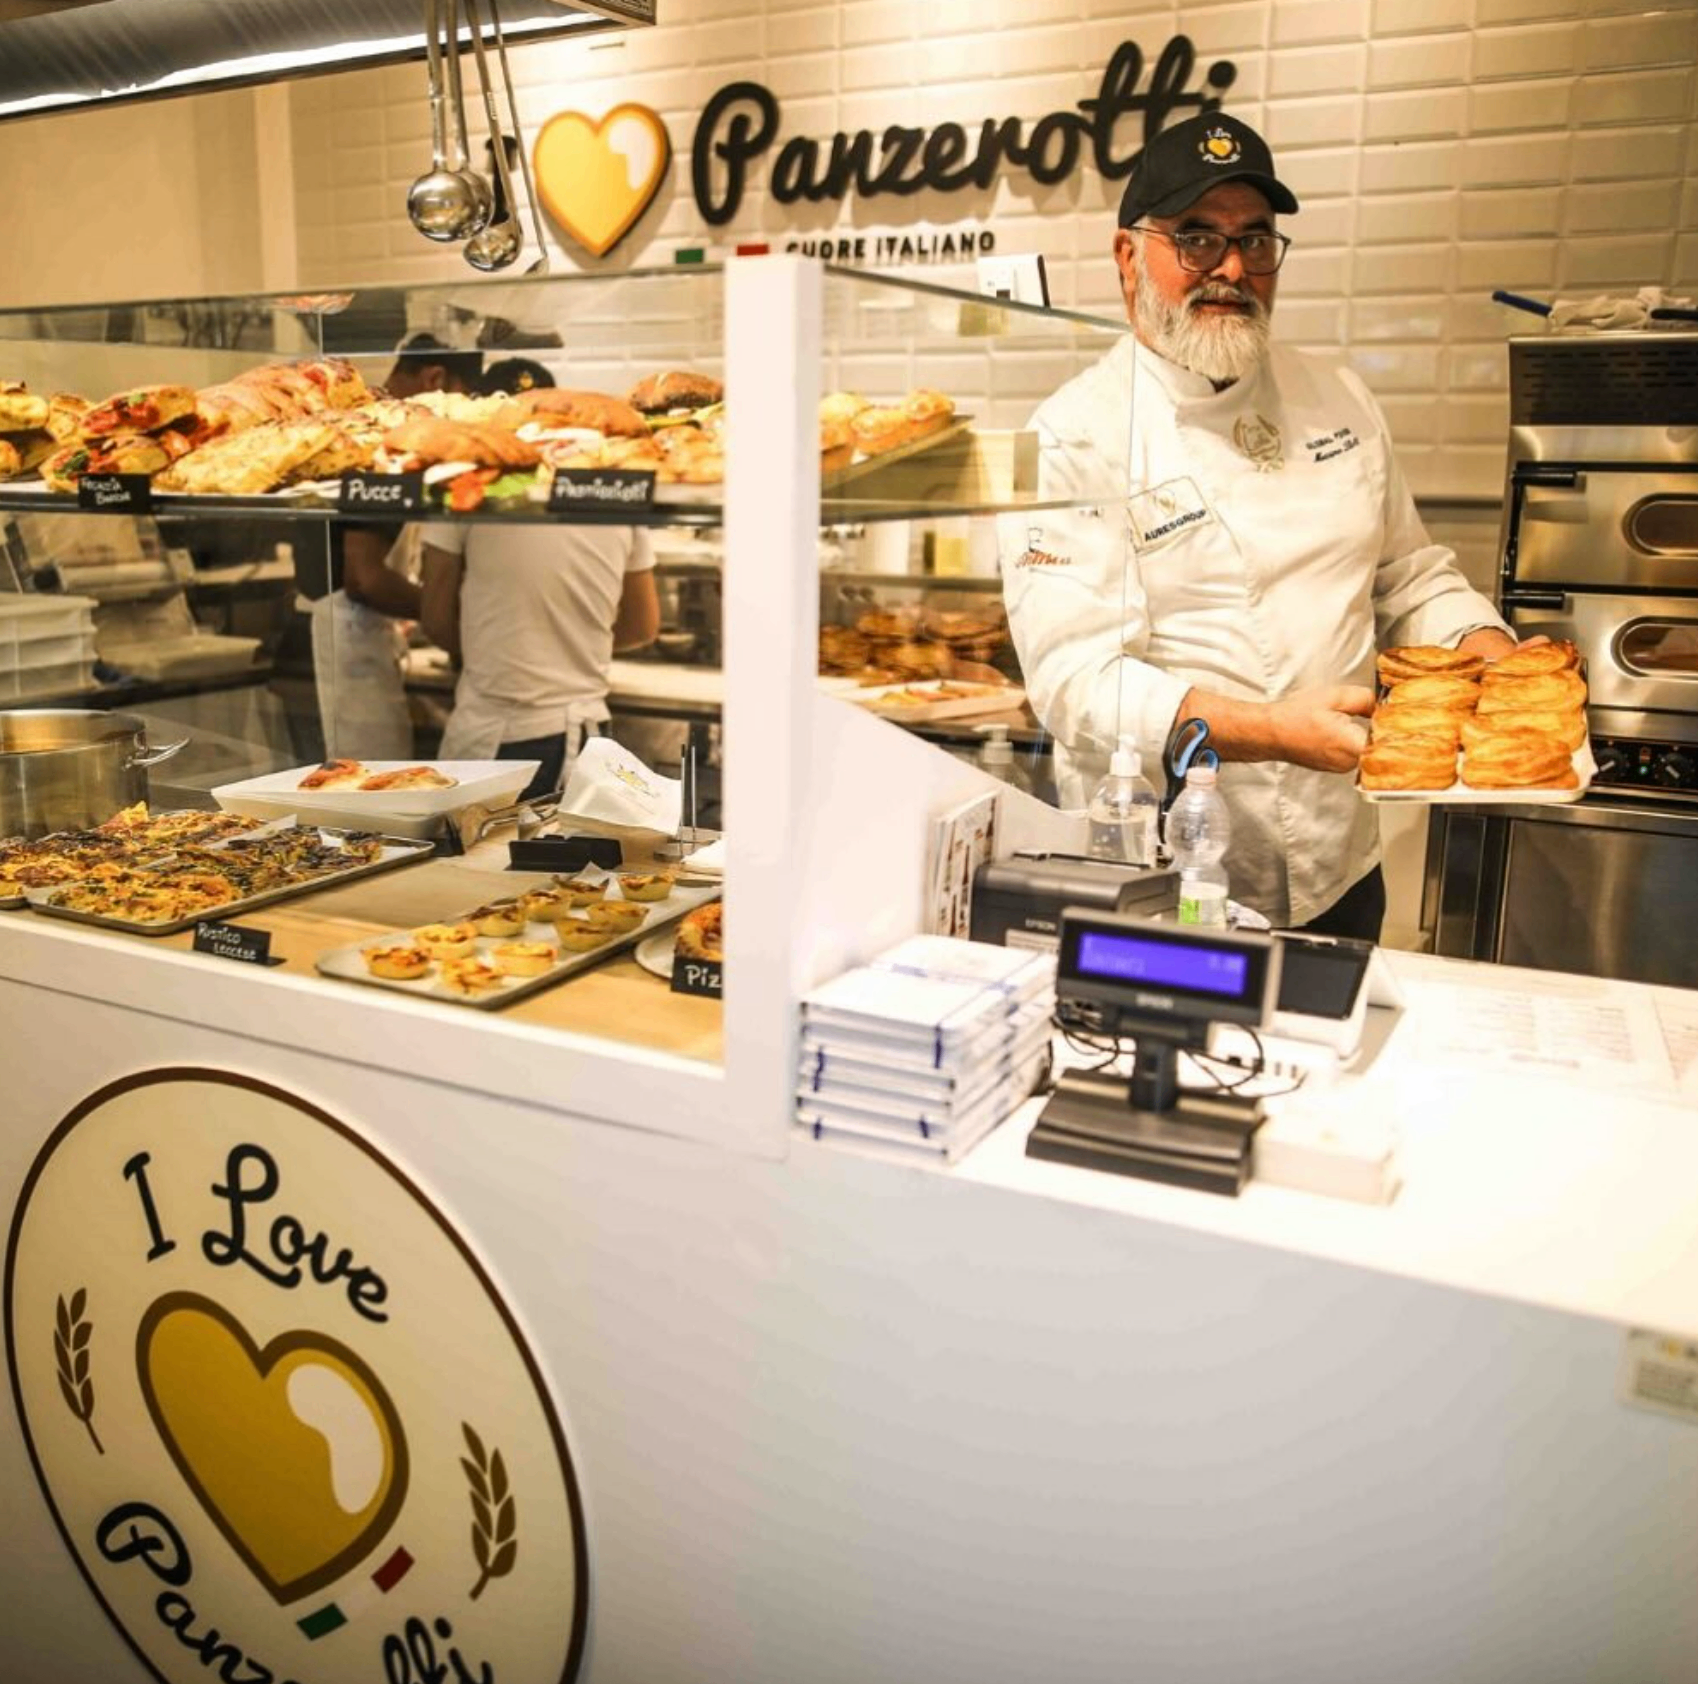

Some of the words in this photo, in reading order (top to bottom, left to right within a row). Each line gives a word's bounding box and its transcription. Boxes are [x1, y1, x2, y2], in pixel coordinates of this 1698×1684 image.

[785, 237, 866, 260] CUORE
[876, 230, 996, 257] ITALIANO
[122, 1151, 177, 1263] I
[201, 1142, 390, 1324] Love
[95, 1501, 494, 1684] Panzti
